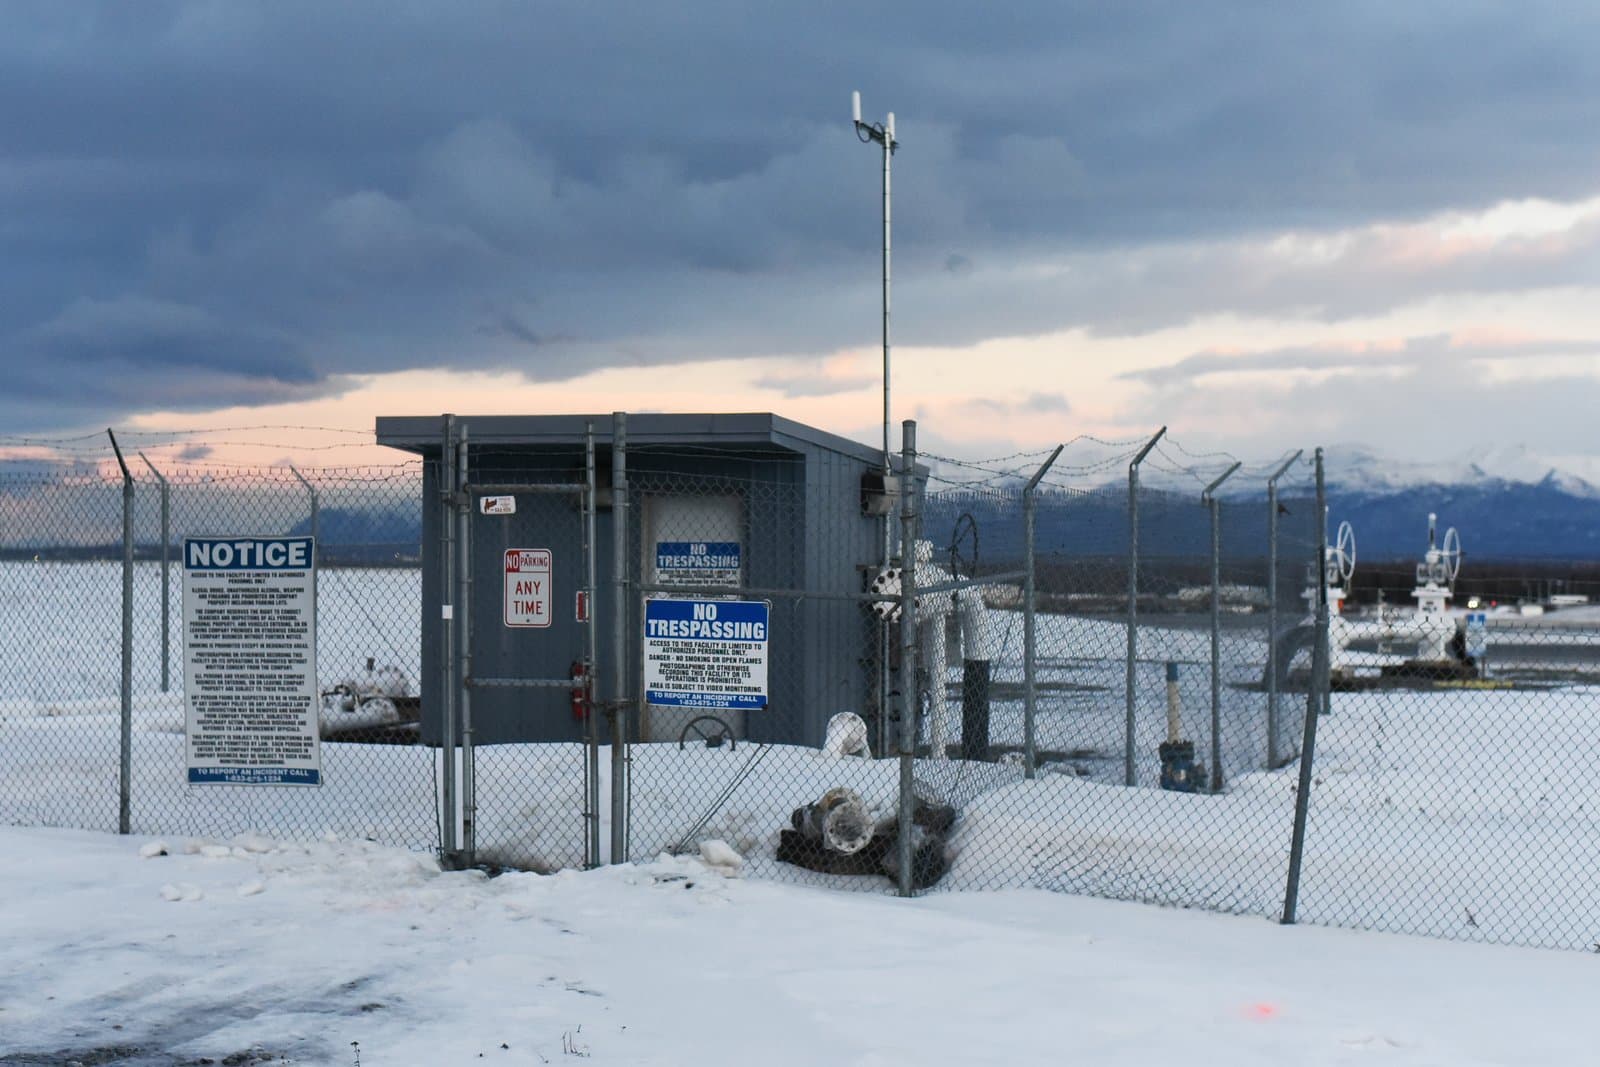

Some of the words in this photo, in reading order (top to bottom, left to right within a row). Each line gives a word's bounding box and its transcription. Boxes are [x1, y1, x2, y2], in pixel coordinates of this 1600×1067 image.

[190, 542, 306, 566] NOTICE
[690, 544, 706, 555] NO
[506, 554, 518, 568] NO
[521, 557, 548, 568] PARKING
[658, 555, 738, 567] TRESPASSING
[516, 581, 540, 595] ANY
[514, 600, 543, 614] TIME
[694, 604, 717, 620] NO
[648, 620, 764, 639] TRESPASSING
